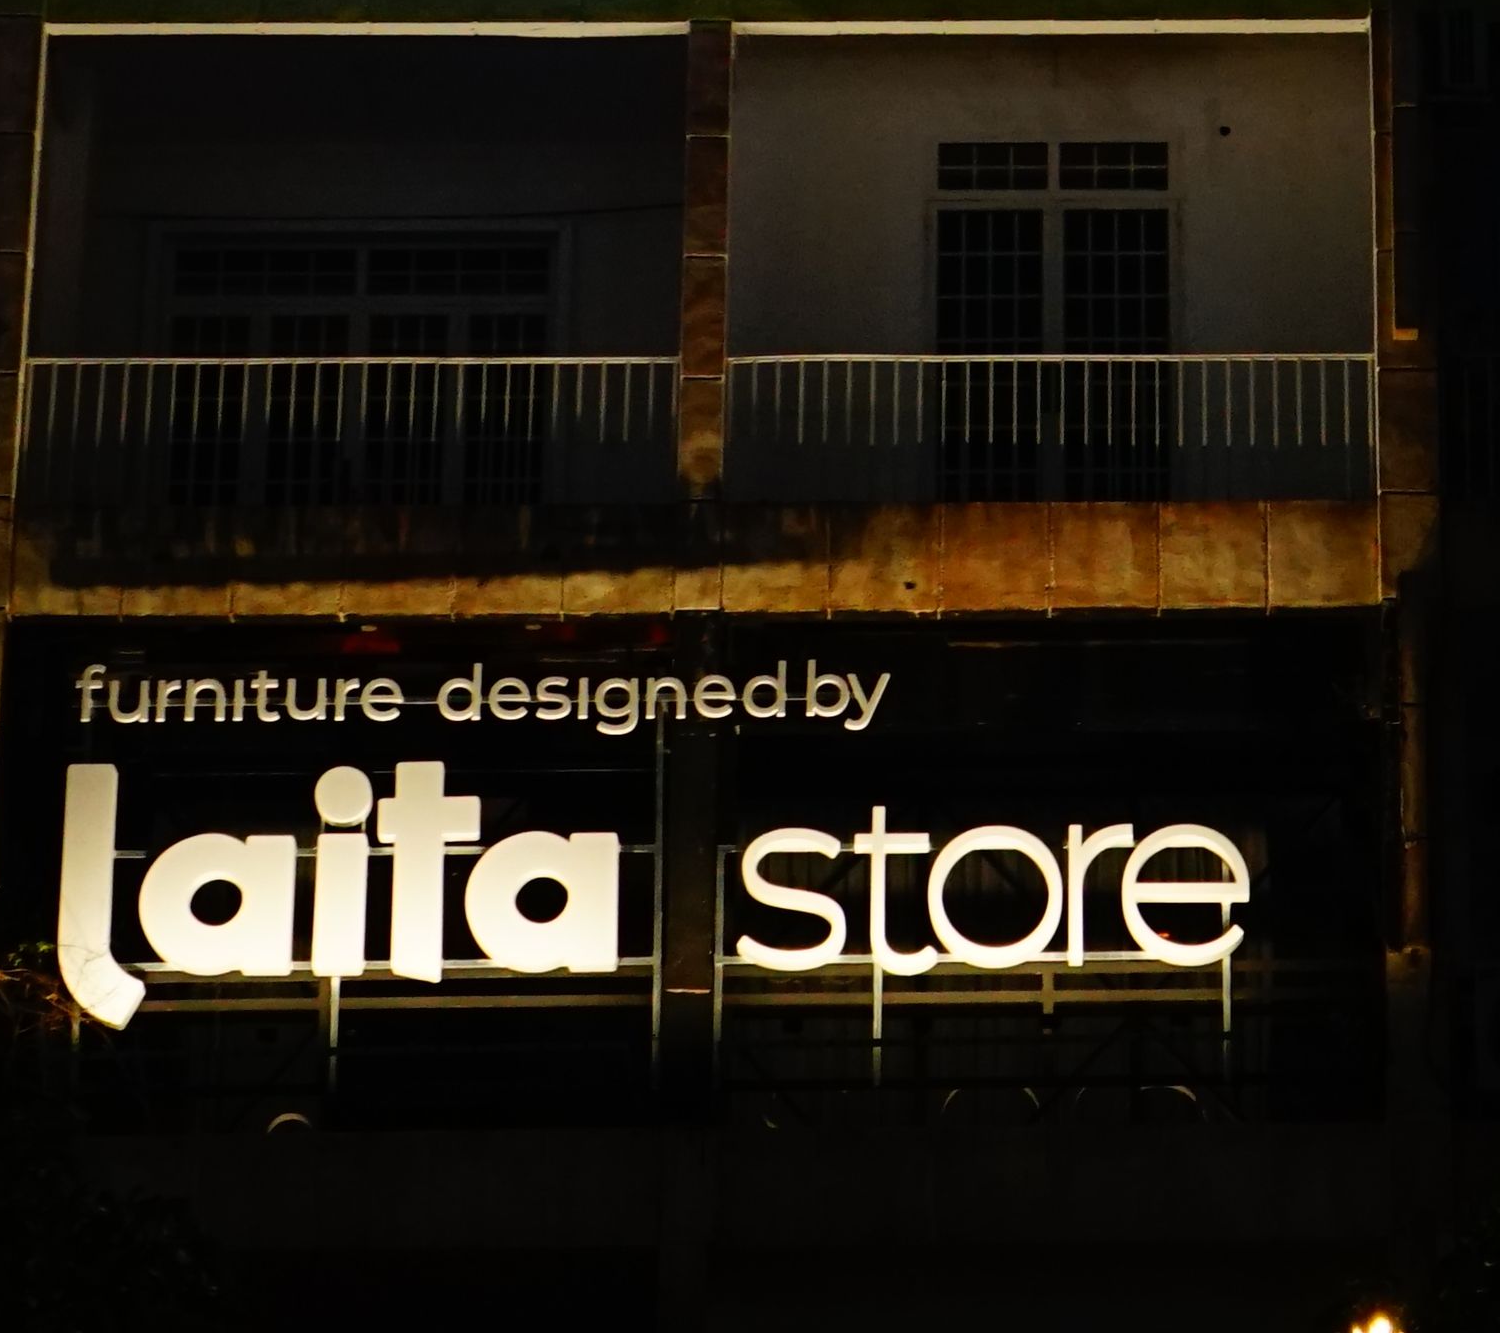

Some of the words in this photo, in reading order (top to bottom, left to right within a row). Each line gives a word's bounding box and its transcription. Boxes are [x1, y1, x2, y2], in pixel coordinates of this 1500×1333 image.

[75, 663, 406, 725] furniture
[437, 660, 789, 736] designed
[804, 659, 892, 731] by
[736, 805, 1253, 976] store
